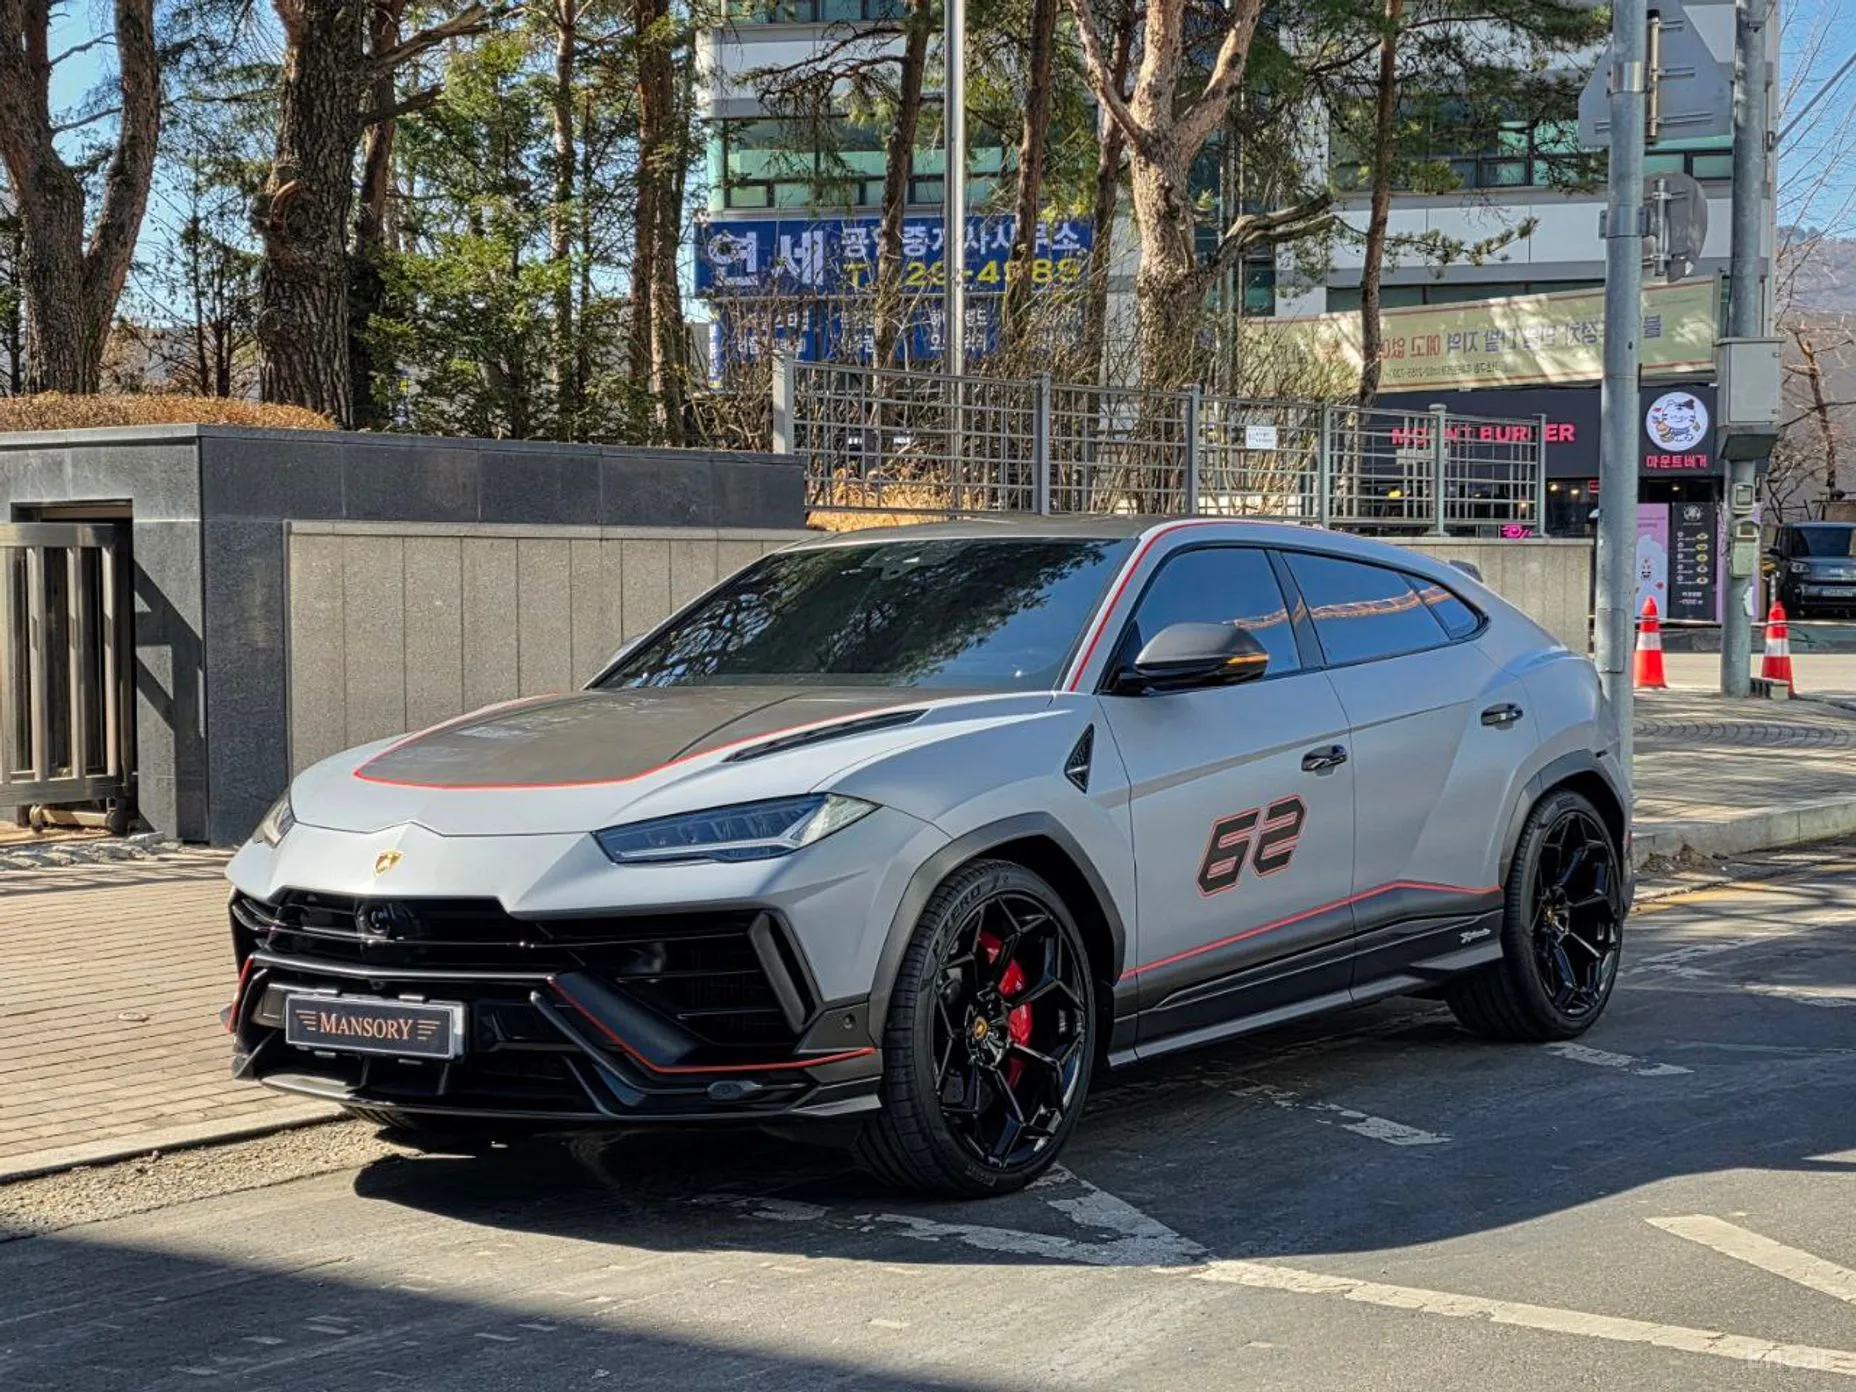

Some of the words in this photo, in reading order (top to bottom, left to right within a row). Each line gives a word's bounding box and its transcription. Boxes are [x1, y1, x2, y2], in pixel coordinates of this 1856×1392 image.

[1391, 426, 1472, 446] MONT
[1646, 454, 1708, 468] 마운트버거
[1196, 794, 1308, 897] 62
[319, 1012, 413, 1040] MANSORY
